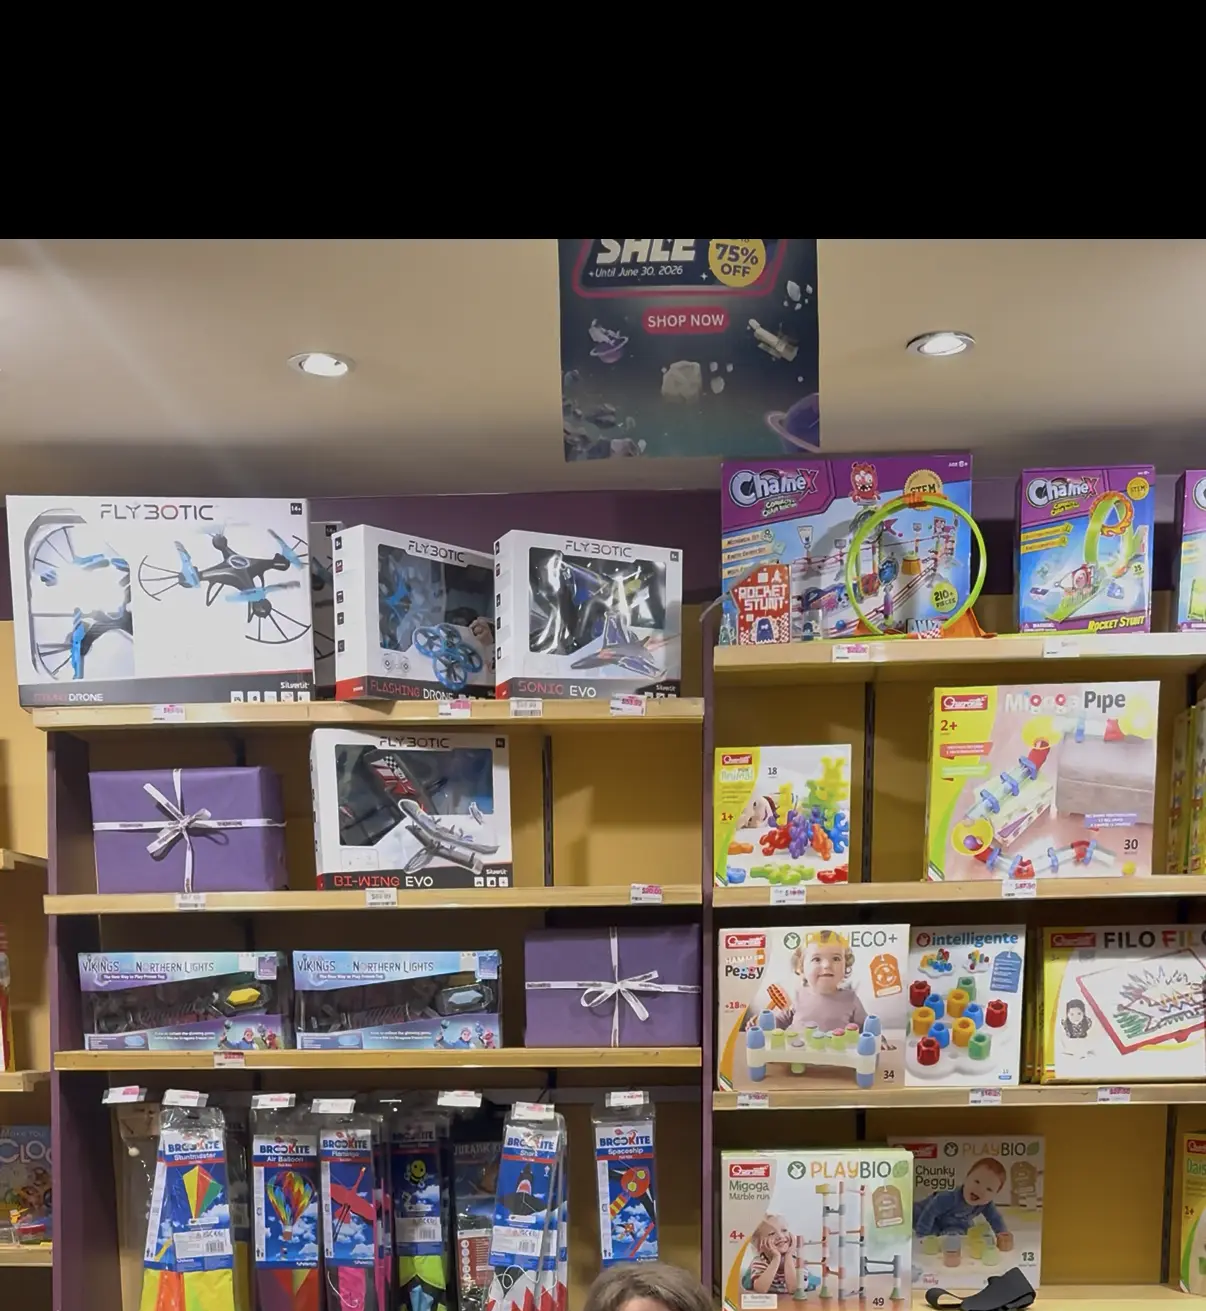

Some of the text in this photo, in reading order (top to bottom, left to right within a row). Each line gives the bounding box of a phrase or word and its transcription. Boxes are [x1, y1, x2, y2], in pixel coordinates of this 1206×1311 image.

[715, 243, 758, 265] 75%
[595, 267, 616, 278] Until
[618, 266, 639, 277] June
[658, 265, 683, 275] 2026
[720, 263, 750, 277] OFF
[647, 314, 725, 327] SHOP NOW
[1087, 616, 1146, 632] ROCKET STUNT
[370, 680, 420, 697] FLASHING
[518, 681, 597, 698] SONIC EVO
[68, 693, 103, 702] DRONE
[1084, 691, 1126, 713] Pipe
[940, 720, 957, 731] 2+
[768, 767, 777, 775] 18
[721, 812, 733, 821] 1+
[1123, 839, 1138, 850] 30
[334, 875, 433, 887] BI-WING EVO
[932, 932, 1018, 947] intelligente
[1104, 931, 1155, 948] FILO
[136, 961, 182, 972] NORTHERN
[185, 961, 214, 973] LIGHTS
[353, 961, 401, 972] NORTHERN
[403, 961, 434, 973] LIGHTS
[725, 965, 764, 979] Peggy
[883, 1070, 894, 1079] 34
[322, 1138, 367, 1149] BROOKITE
[600, 1133, 650, 1147] BROOKITE
[260, 1143, 310, 1154] BROOKITE
[962, 1142, 1026, 1156] PLAYBIO
[810, 1160, 891, 1179] PLAYBIO
[915, 1165, 955, 1177] Chunky
[729, 1180, 770, 1192] Migoga
[915, 1176, 955, 1190] Peggy
[729, 1192, 755, 1200] Marble
[729, 1230, 745, 1239] 4+
[1021, 1251, 1034, 1261] 13
[872, 1297, 884, 1306] 49
